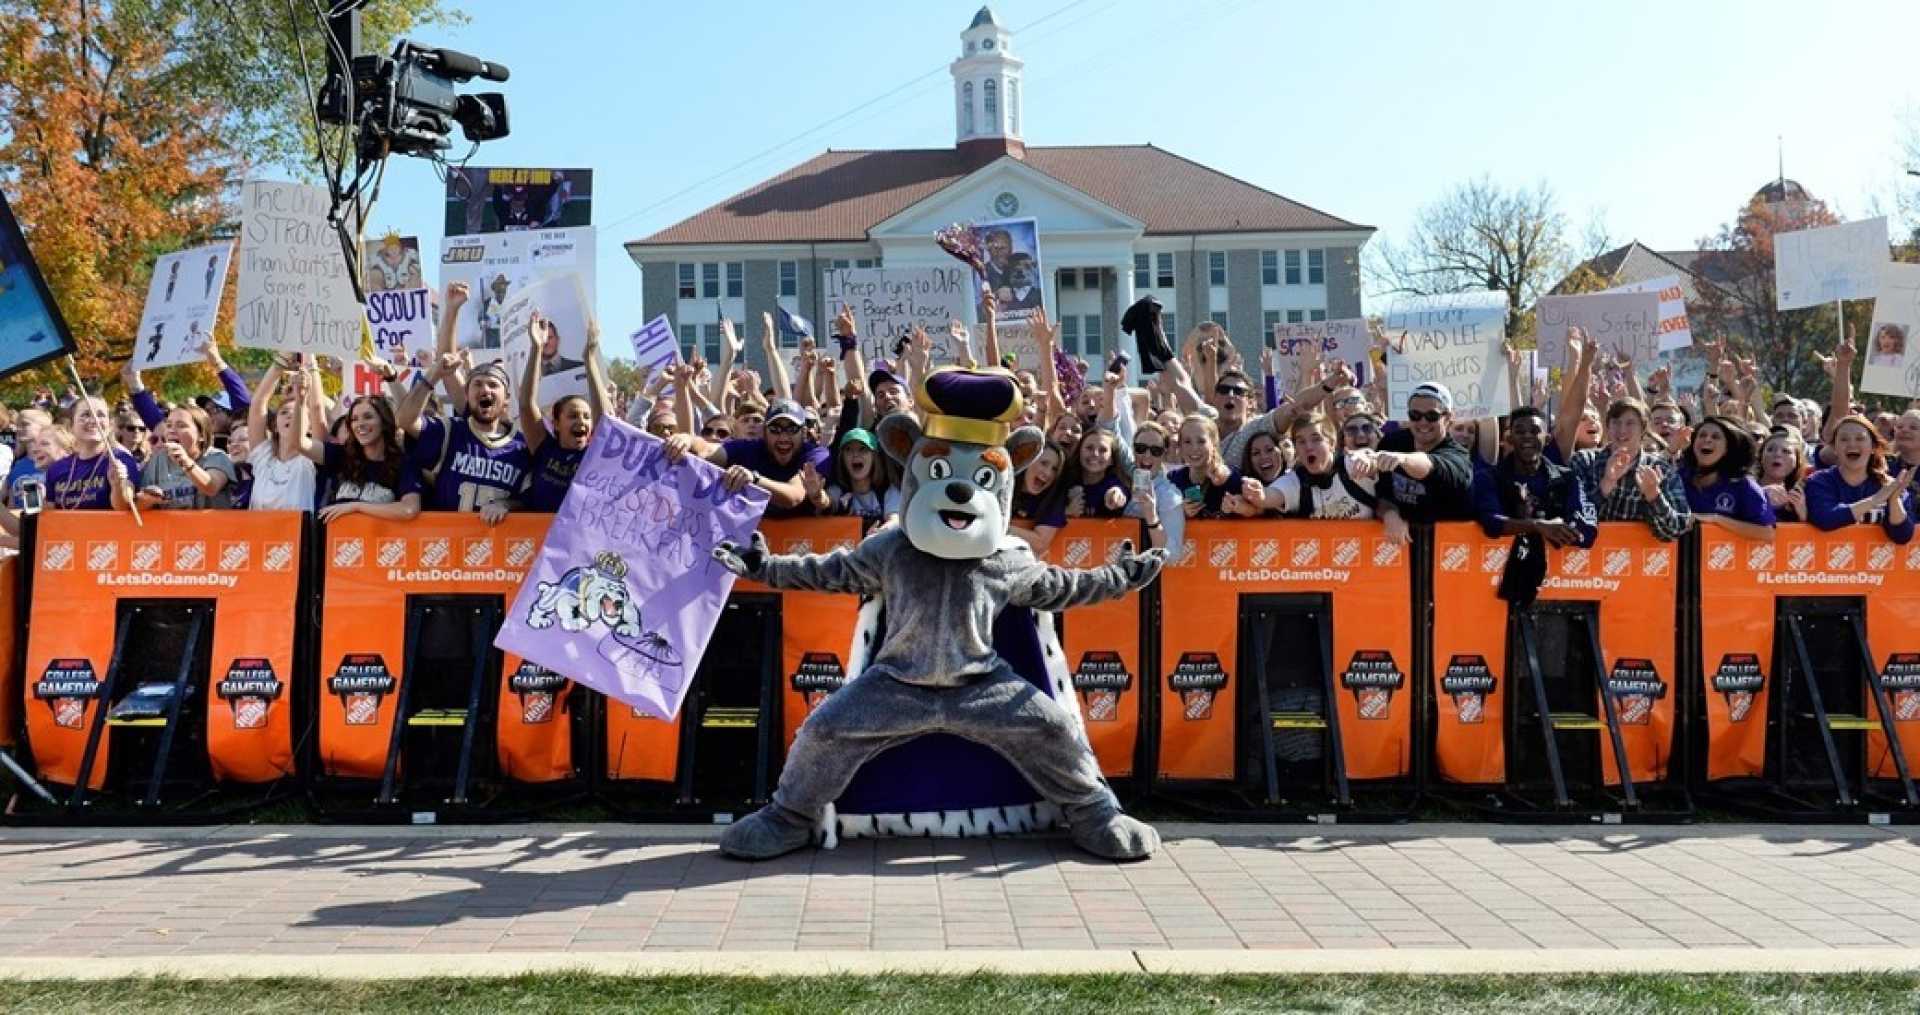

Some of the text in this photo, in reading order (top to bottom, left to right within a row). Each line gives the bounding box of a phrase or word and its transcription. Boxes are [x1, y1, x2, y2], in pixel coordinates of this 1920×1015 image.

[442, 245, 485, 264] JMU
[263, 274, 307, 297] Game
[825, 269, 839, 297] I
[914, 276, 930, 294] to
[932, 266, 961, 294] DVR
[367, 289, 429, 324] SCOUT
[375, 327, 412, 351] for
[97, 572, 238, 588] #LetsDoGameDay
[387, 569, 524, 584] #LetsDoGameDay
[1219, 567, 1350, 583] #LetsDoGameDay
[1757, 571, 1884, 586] #LetsDoGameDay
[1491, 576, 1621, 591] #oGameDay
[339, 665, 385, 675] COLLEGE
[1080, 661, 1122, 671] COLLEGE
[1179, 662, 1218, 672] COLLEGE
[1351, 661, 1393, 671] COLLEGE
[1448, 665, 1487, 675] COLLEGE
[45, 670, 92, 680] COLLEGE
[228, 670, 271, 680] COLLEGE
[1074, 674, 1129, 685] GAMEDAY
[1173, 673, 1225, 684] GAMEDAY
[1346, 673, 1401, 684] GAMEDAY
[1613, 669, 1655, 678] COLLEGE
[38, 682, 98, 694] GAMEDAY
[221, 682, 279, 694] GAMEDAY
[333, 677, 392, 689] GAMEDAY
[1445, 676, 1493, 688] GAMEDAY
[1608, 680, 1663, 691] GAMEDAY
